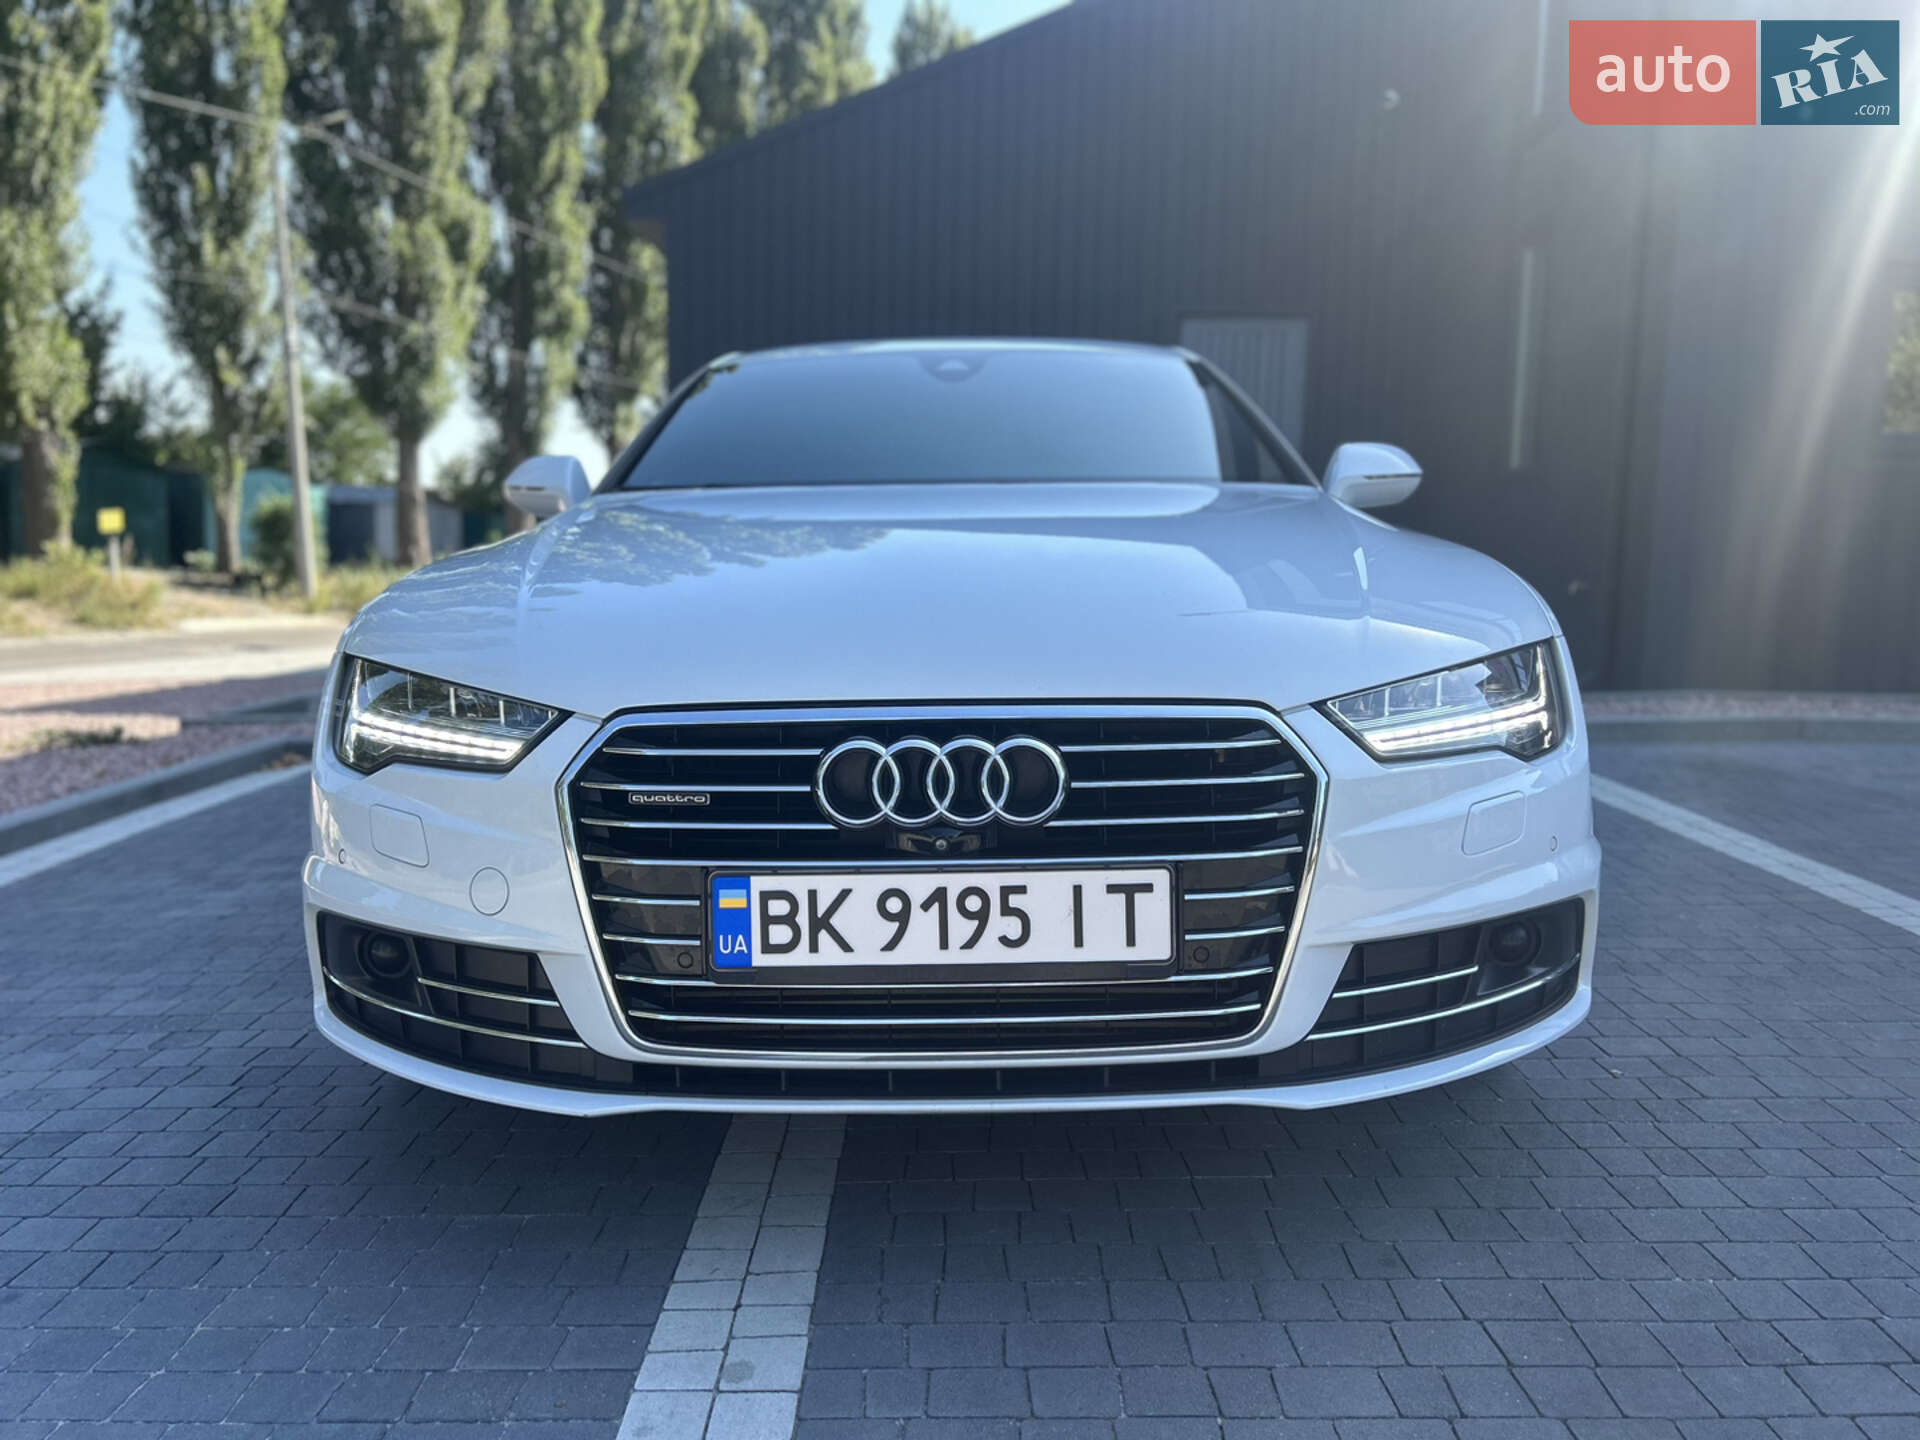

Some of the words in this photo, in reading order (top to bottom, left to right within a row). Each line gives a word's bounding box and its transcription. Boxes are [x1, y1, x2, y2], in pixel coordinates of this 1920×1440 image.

[632, 794, 706, 803] quattro
[758, 888, 855, 955] BK
[876, 884, 1032, 952] 9195
[1072, 882, 1154, 949] IT
[719, 934, 749, 954] UA
